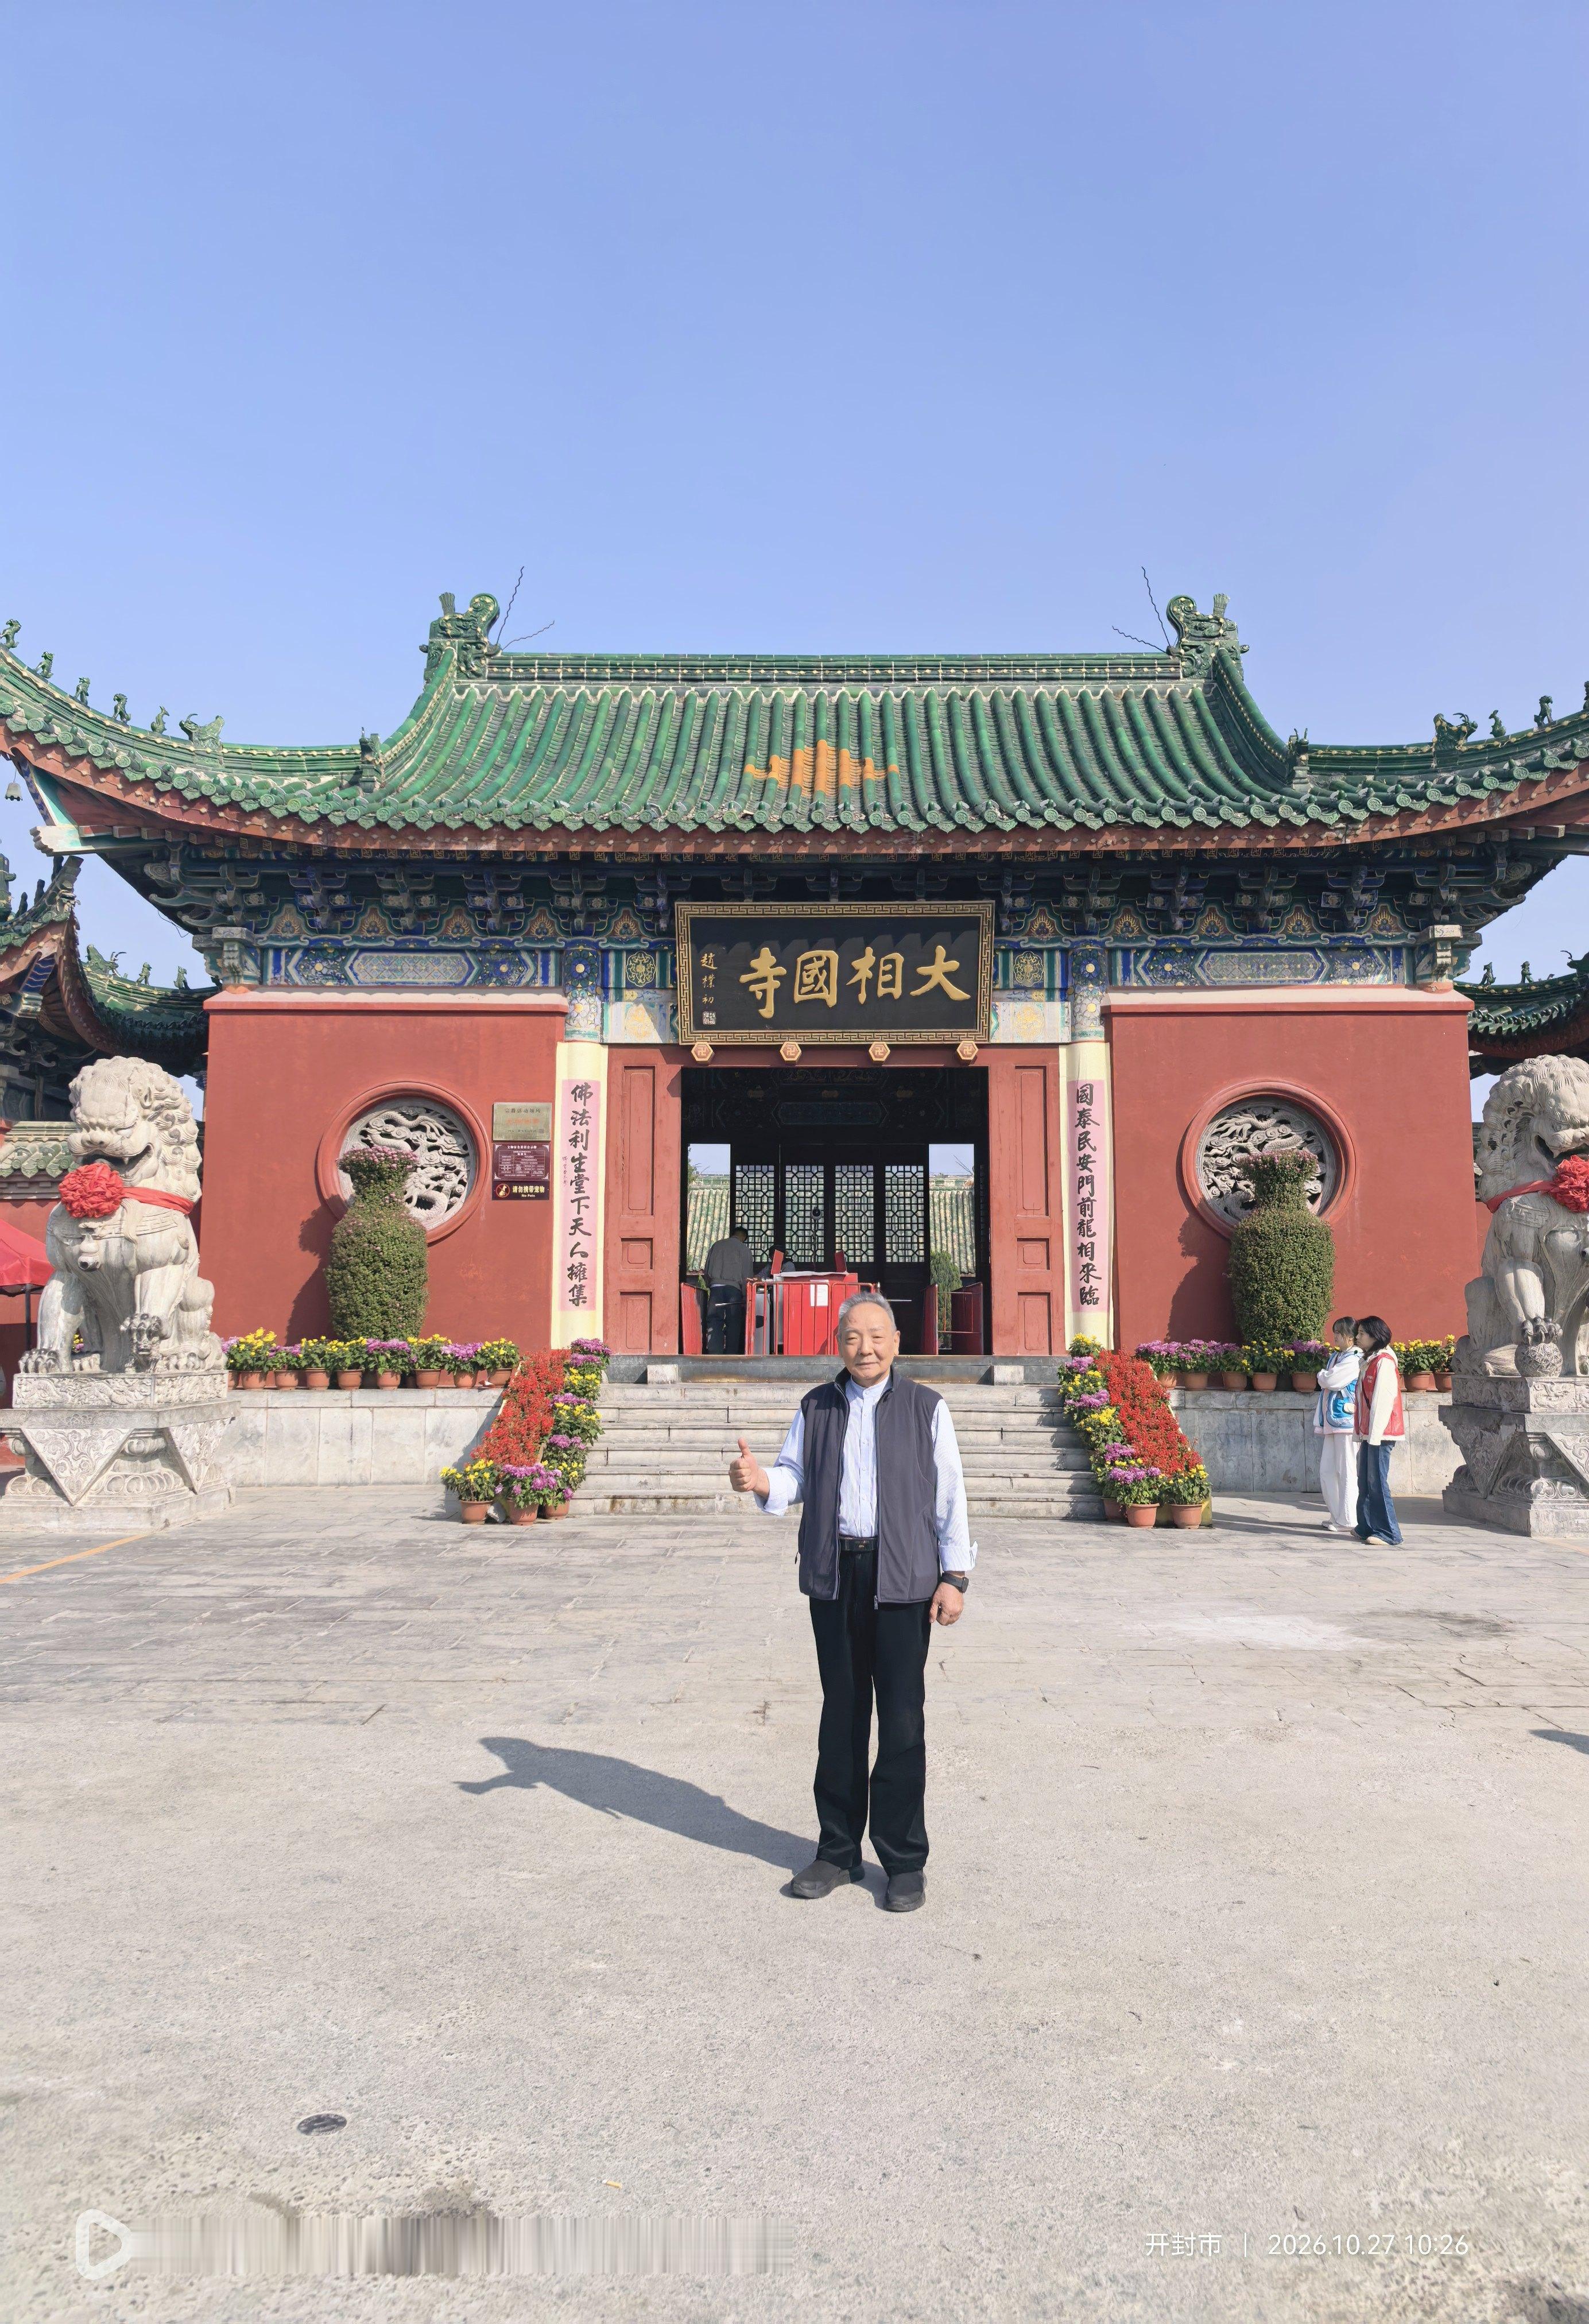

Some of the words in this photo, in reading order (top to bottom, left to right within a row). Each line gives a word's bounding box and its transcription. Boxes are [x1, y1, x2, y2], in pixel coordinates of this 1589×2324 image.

[739, 946, 970, 1018] 大相國寺
[512, 1185, 545, 1193] 请勿携带宠物
[1074, 1083, 1102, 1306] 國泰民安門前龍相來臨
